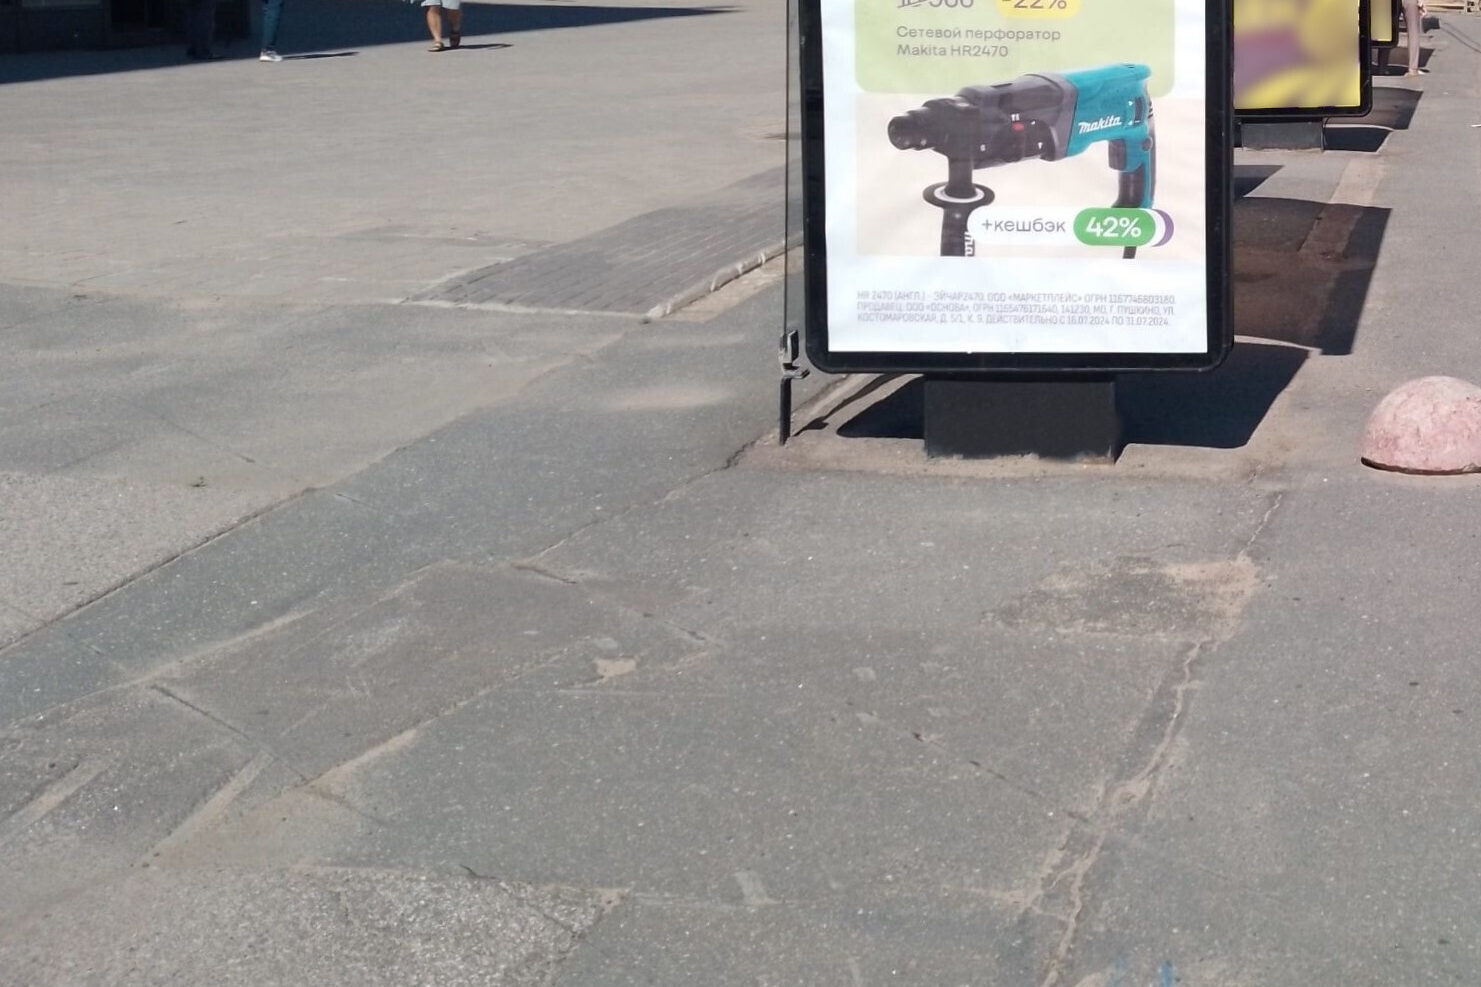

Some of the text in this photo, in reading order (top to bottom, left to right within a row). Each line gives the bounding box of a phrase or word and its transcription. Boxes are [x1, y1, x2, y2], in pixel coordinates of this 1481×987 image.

[896, 25, 1061, 41] Сетевой перфоратор
[897, 43, 1009, 58] Makita HR2470
[981, 216, 1142, 238] +кешбэк 42%
[987, 292, 1006, 302] ООО
[1084, 293, 1107, 303] ОГРН
